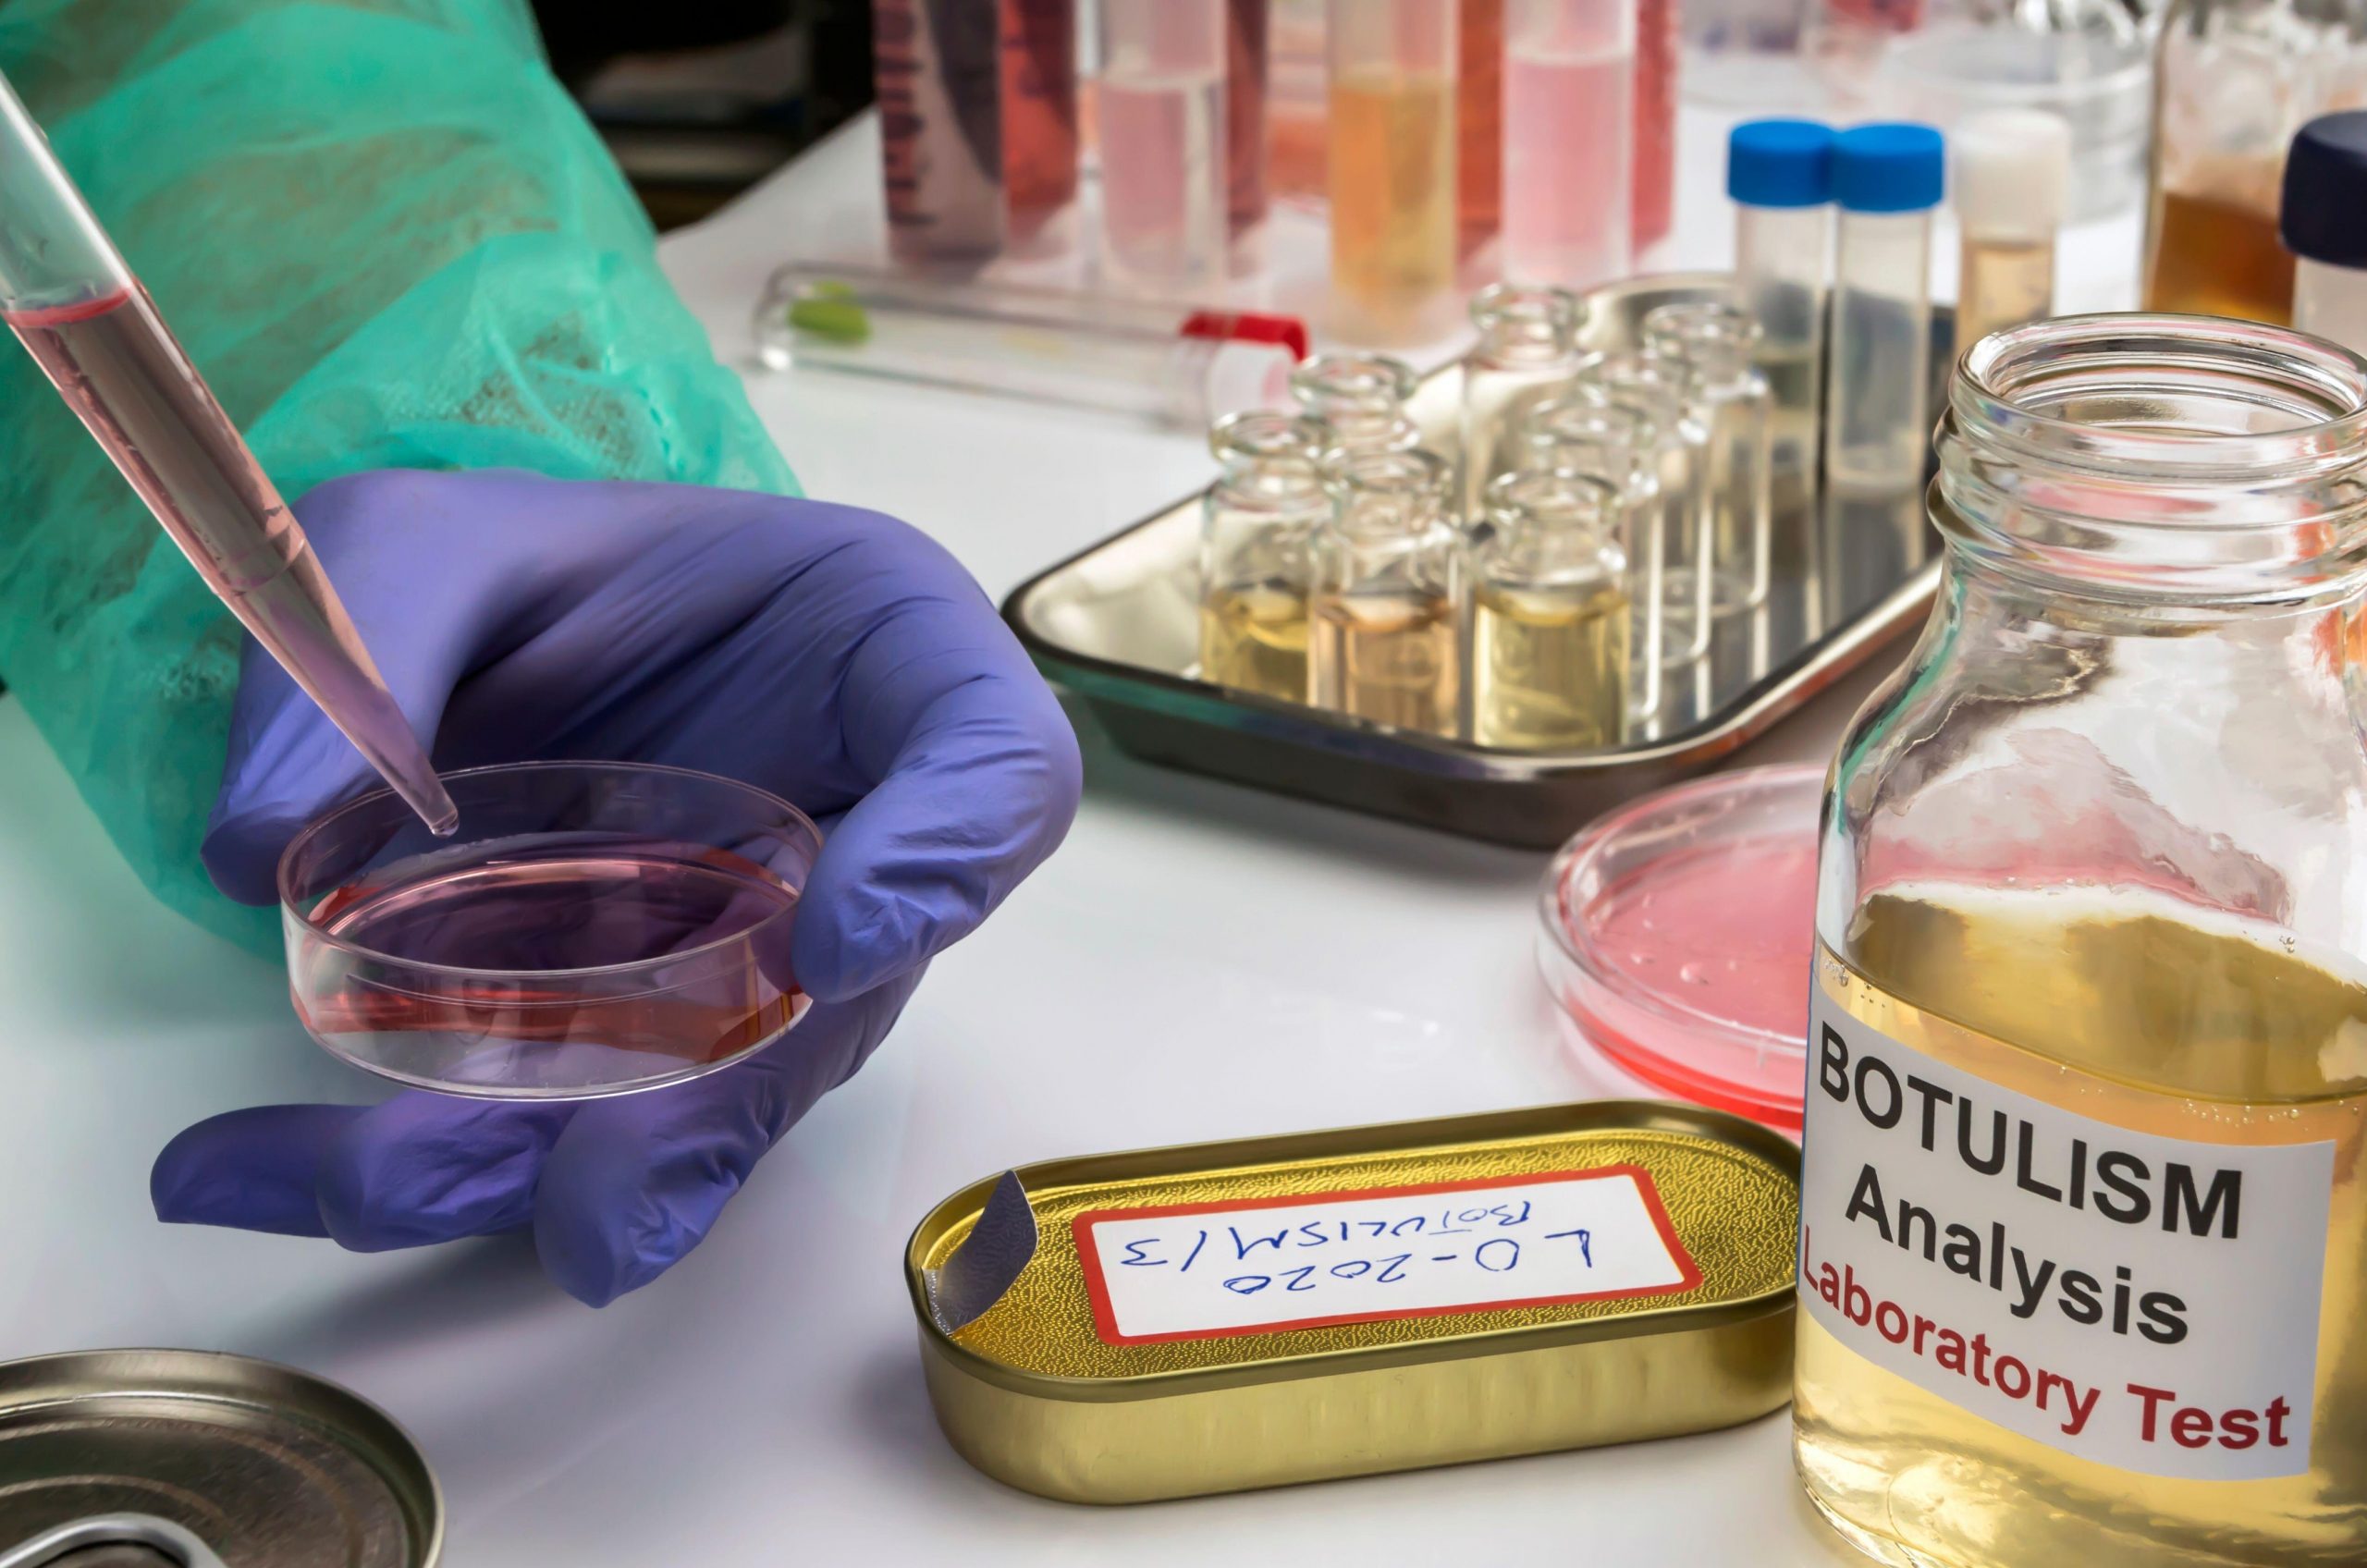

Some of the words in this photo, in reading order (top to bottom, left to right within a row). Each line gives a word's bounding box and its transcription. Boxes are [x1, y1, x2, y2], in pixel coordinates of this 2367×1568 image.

[1820, 1020, 2243, 1240] BOTULISM
[1803, 1224, 2101, 1436] Laboratory
[2127, 1382, 2290, 1451] Test
[1845, 1162, 2189, 1345] Analysis
